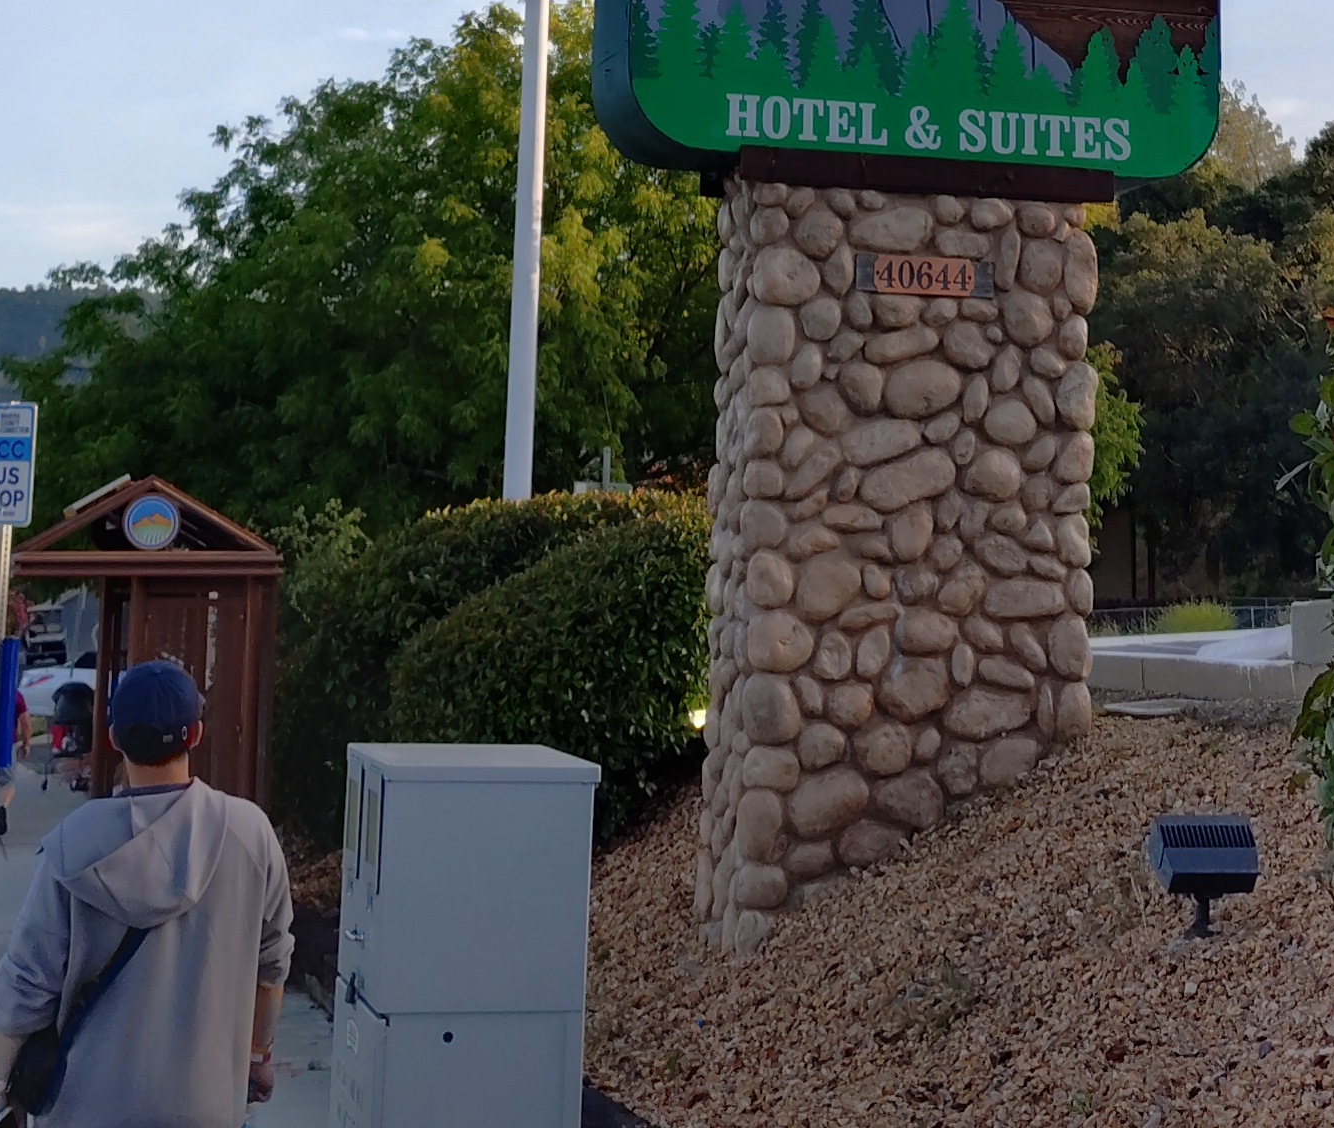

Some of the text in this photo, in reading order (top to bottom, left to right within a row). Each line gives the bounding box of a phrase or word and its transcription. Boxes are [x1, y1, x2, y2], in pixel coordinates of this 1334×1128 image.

[725, 93, 1132, 161] HOTEL & SUITES
[878, 260, 970, 291] 40644
